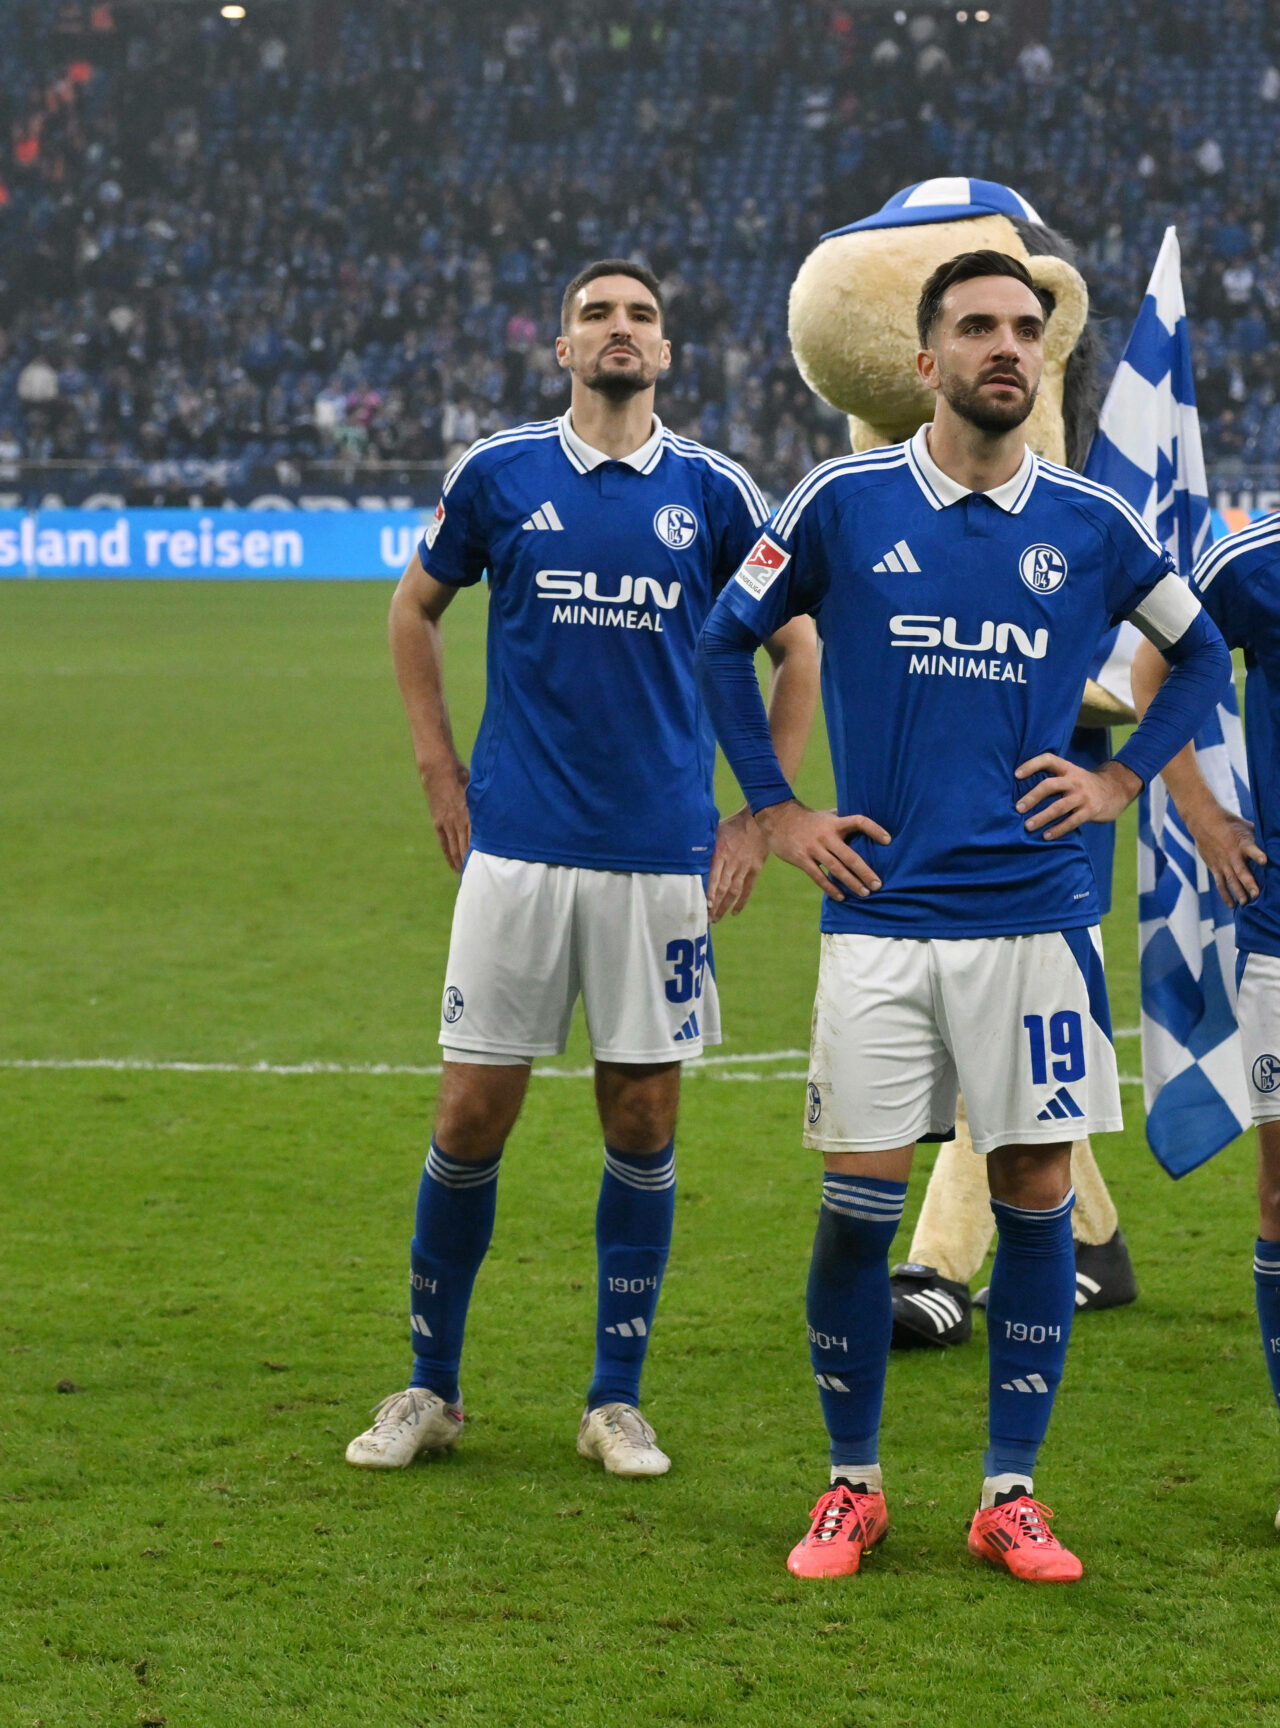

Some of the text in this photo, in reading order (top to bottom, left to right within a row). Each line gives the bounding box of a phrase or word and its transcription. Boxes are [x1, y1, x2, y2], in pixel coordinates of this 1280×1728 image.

[144, 517, 303, 568] reisen
[535, 570, 682, 610] SUN
[552, 605, 664, 633] MINIMEAL
[889, 615, 1049, 659] SUN
[908, 654, 1028, 684] MINIMEAL
[1023, 1010, 1086, 1085] 19
[608, 1275, 657, 1294] 1904
[1004, 1321, 1061, 1344] 1904
